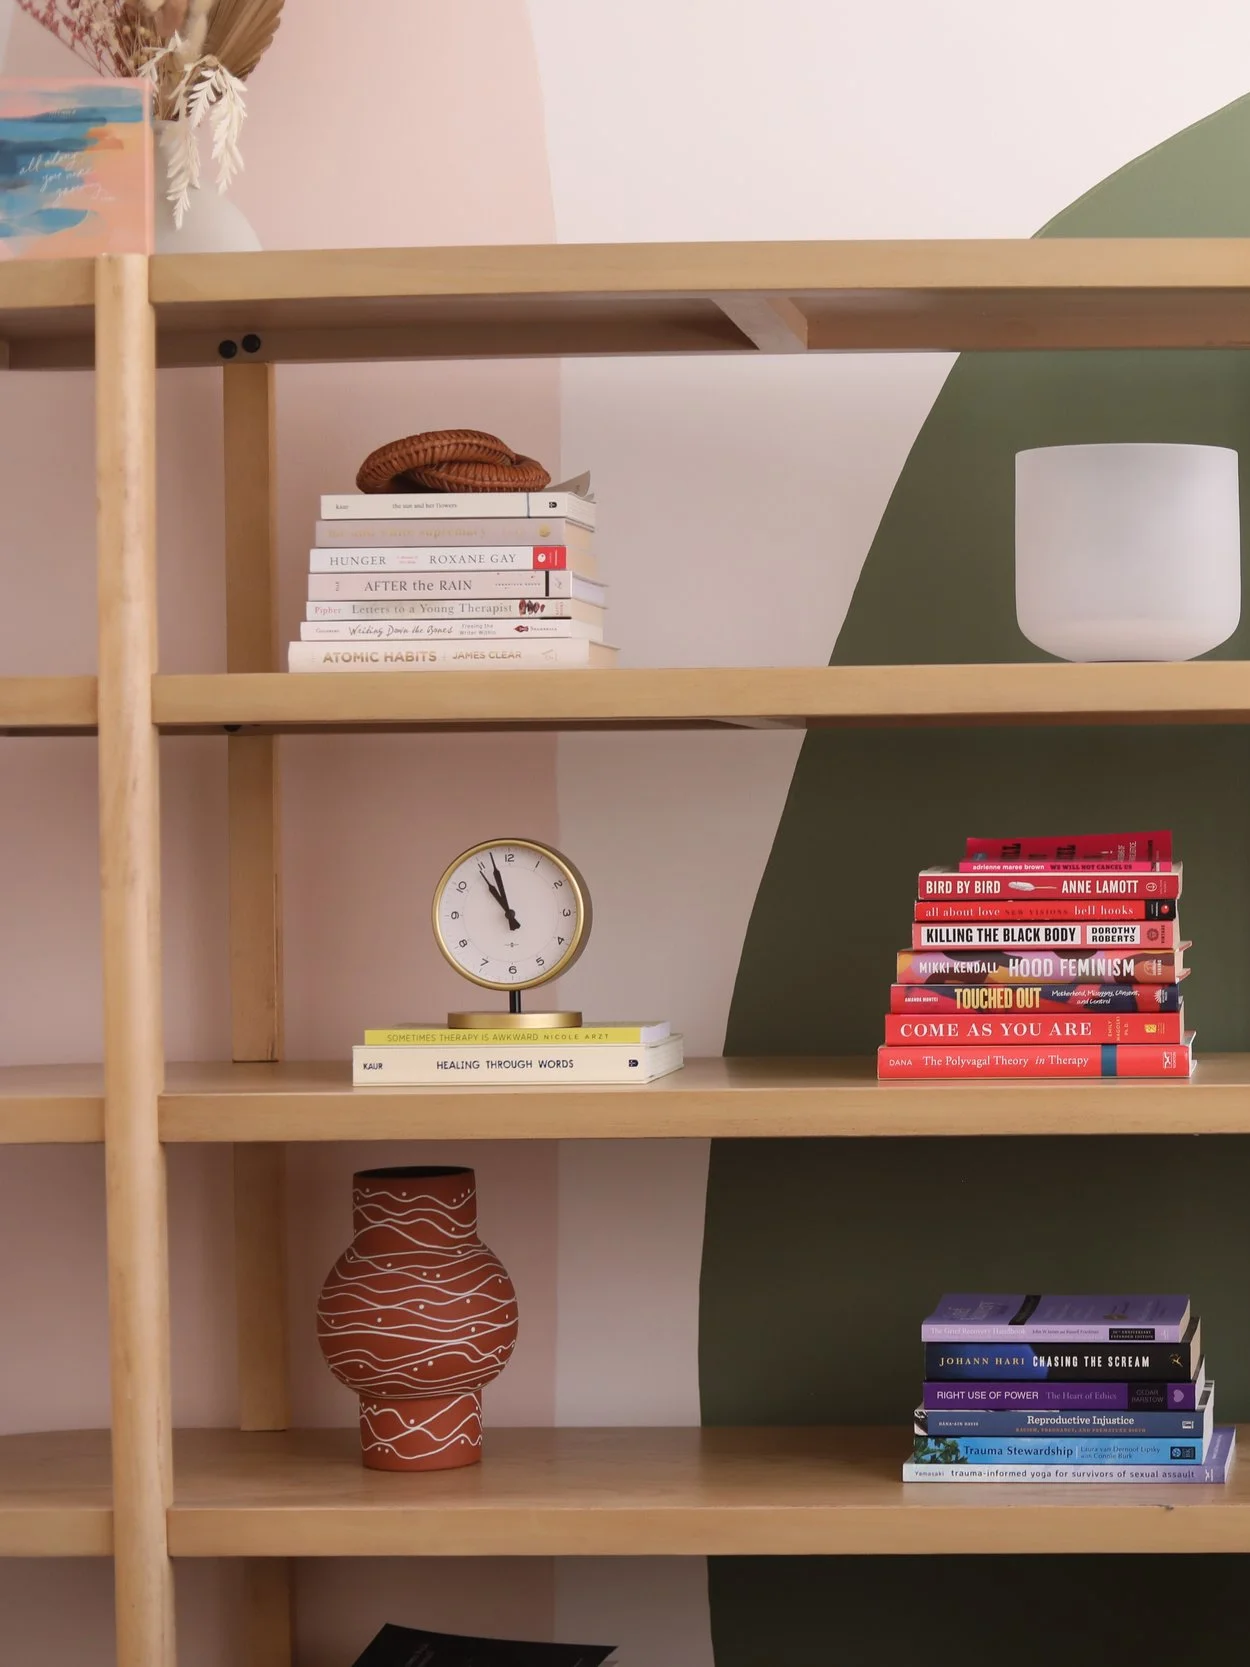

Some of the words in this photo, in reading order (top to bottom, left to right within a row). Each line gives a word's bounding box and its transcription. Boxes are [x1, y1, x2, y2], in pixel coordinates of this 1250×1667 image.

[330, 556, 386, 566] HUNGER
[429, 554, 486, 564] ROXANE
[490, 554, 516, 564] GAY
[364, 581, 408, 592] AFTER
[412, 580, 434, 591] the
[439, 580, 472, 591] RAIN
[314, 606, 342, 616] Pipher
[352, 604, 390, 614] Letters
[394, 605, 404, 614] to
[408, 606, 415, 614] a
[420, 603, 454, 614] Young
[459, 603, 512, 615] Therapist
[348, 624, 383, 638] Writing
[386, 624, 408, 637] Down
[412, 625, 424, 634] the
[426, 624, 453, 635] Bones
[322, 652, 380, 664] ATOMIC
[384, 650, 437, 662] HABITS
[452, 651, 486, 660] JAMES
[488, 650, 522, 660] CLEAR
[504, 854, 515, 862] 12
[477, 861, 486, 870] 11
[535, 860, 541, 868] 1
[456, 880, 468, 894] 10
[553, 880, 563, 890] 2
[926, 880, 952, 894] BIRD
[956, 880, 970, 894] BY
[974, 880, 1000, 894] BIRD
[1062, 880, 1092, 894] ANNE
[1096, 880, 1138, 894] LAMOTT
[562, 908, 572, 917] 3
[926, 906, 938, 917] all
[943, 906, 973, 917] about
[978, 906, 1000, 916] love
[1029, 908, 1068, 916] VISIONS
[1074, 905, 1096, 916] bell
[1100, 904, 1134, 916] hooks
[450, 911, 460, 920] 9
[1092, 926, 1136, 934] DOROTHY
[926, 928, 973, 943] KILLING
[976, 928, 999, 943] THE
[1003, 928, 1040, 943] BLACK
[1044, 928, 1076, 942] BODY
[1092, 934, 1135, 942] ROBERTS
[458, 939, 468, 948] 8
[557, 936, 565, 946] 4
[480, 958, 490, 966] 7
[536, 956, 545, 966] 5
[508, 966, 518, 974] 6
[919, 962, 950, 974] MIKKI
[953, 961, 998, 974] KENDALL
[1008, 958, 1053, 978] HOOD
[1060, 958, 1134, 977] FEMINISM
[954, 988, 1012, 1010] TOUCHED
[1016, 987, 1042, 1009] OUT
[1052, 990, 1087, 998] Motherhood,
[900, 1023, 958, 1038] COME
[966, 1023, 992, 1038] AS
[1000, 1022, 1042, 1037] YOU
[1050, 1022, 1092, 1036] ARE
[387, 1034, 436, 1042] SOMETIMES
[439, 1034, 478, 1042] THERAPY
[492, 1033, 539, 1041] AWKWARD
[363, 1062, 384, 1070] KAUR
[436, 1060, 480, 1070] HEALING
[486, 1060, 533, 1070] THROUGH
[538, 1060, 574, 1068] WORDS
[922, 1056, 942, 1066] The
[945, 1056, 990, 1068] Polyvagal
[993, 1056, 1029, 1067] Theory
[1035, 1056, 1045, 1064] in
[1048, 1055, 1089, 1067] Therapy
[962, 1328, 992, 1336] Recovery
[939, 1357, 989, 1366] JOHANN
[995, 1357, 1025, 1366] HARI
[1032, 1356, 1078, 1368] CHASING
[1084, 1356, 1102, 1368] THE
[1108, 1356, 1150, 1368] SCREAM
[936, 1391, 966, 1400] RIGHT
[968, 1391, 986, 1400] USE
[988, 1391, 1002, 1400] OF
[1004, 1391, 1038, 1400] POWER
[1046, 1392, 1061, 1400] The
[1062, 1392, 1083, 1400] Heart
[1084, 1392, 1093, 1400] of
[1094, 1392, 1116, 1400] Ethics
[1027, 1416, 1090, 1427] Reproductive
[1092, 1416, 1134, 1427] Injustice
[964, 1446, 1003, 1456] Trauma
[1007, 1446, 1073, 1458] Stewardship
[1140, 1446, 1160, 1454] Lipsky
[951, 1470, 1027, 1478] trauma-informed
[1056, 1470, 1068, 1478] for
[1072, 1470, 1114, 1478] survivors
[1117, 1470, 1126, 1478] of
[1130, 1470, 1158, 1478] sexual
[1162, 1470, 1194, 1478] assault
